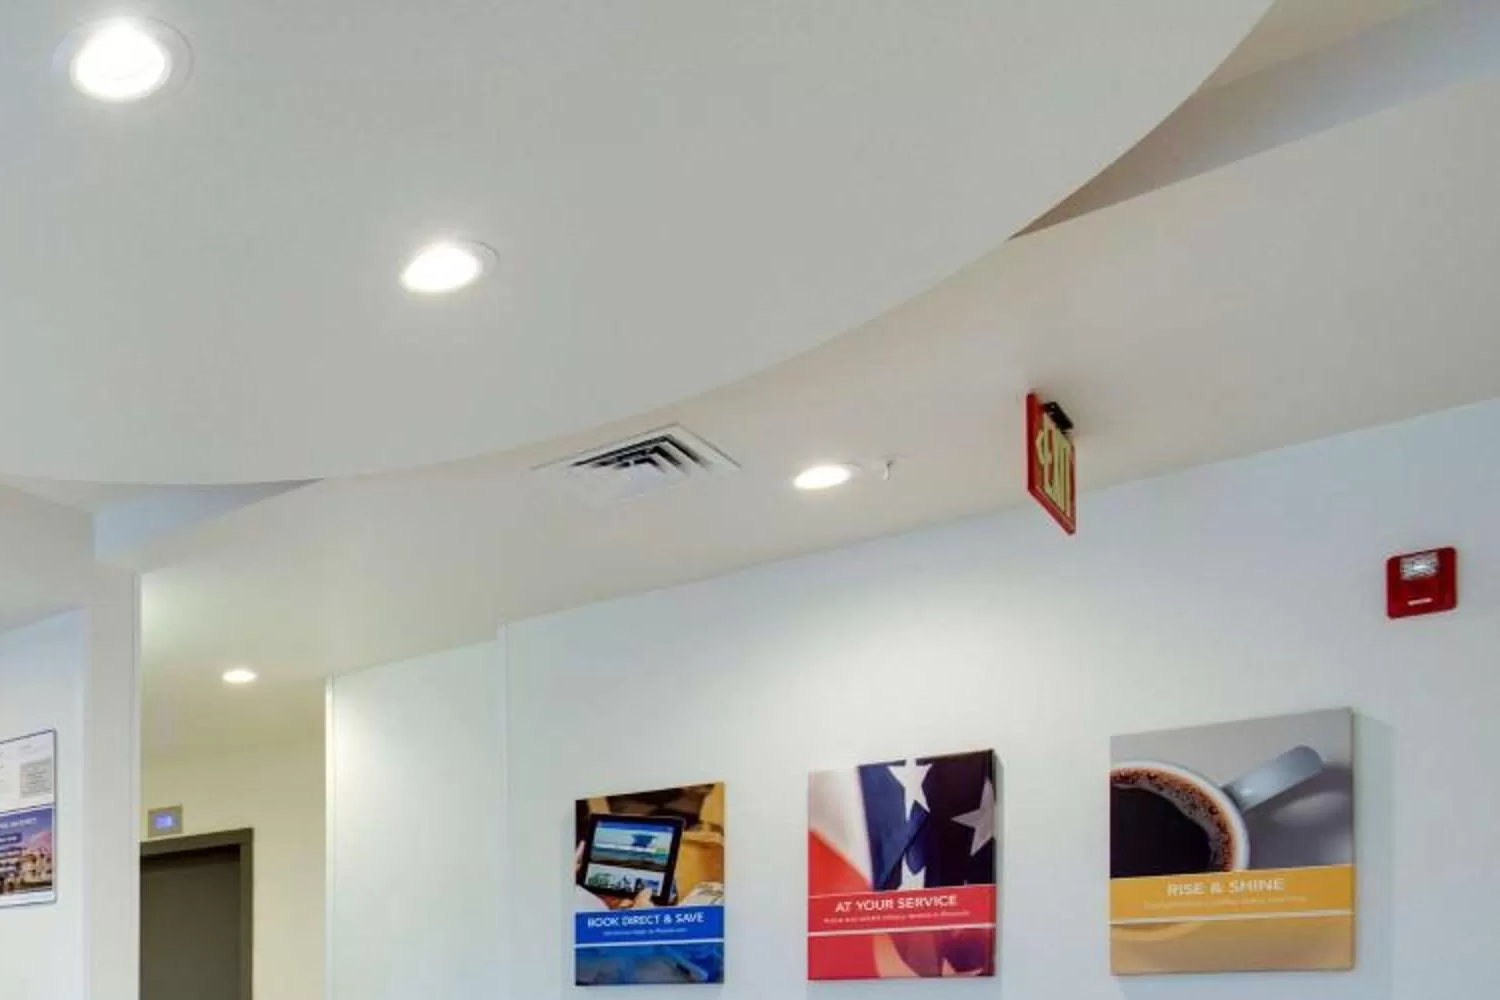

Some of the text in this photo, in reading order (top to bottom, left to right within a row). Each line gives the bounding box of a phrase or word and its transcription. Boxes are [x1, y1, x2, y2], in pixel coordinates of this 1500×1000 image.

[1167, 878, 1285, 897] RISE & SHINE
[835, 894, 958, 913] AT YOUR SERVICE
[587, 911, 705, 928] BOOK DIRECT & SAVE
